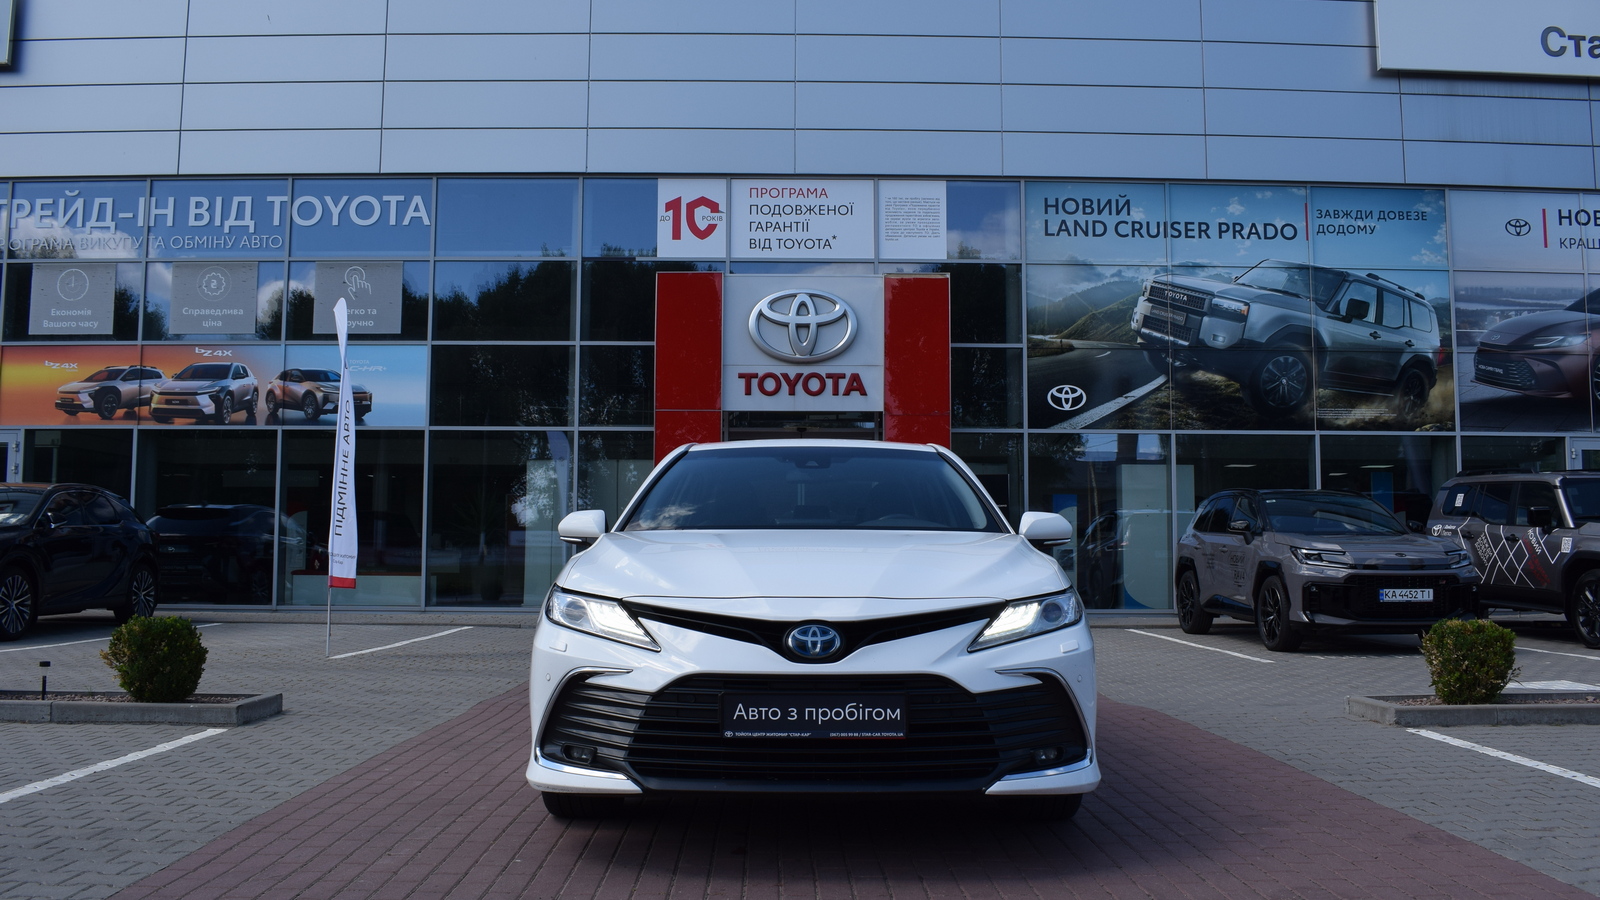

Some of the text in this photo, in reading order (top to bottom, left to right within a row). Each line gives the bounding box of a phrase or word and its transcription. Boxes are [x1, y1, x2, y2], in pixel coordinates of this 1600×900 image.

[750, 187, 828, 198] ПРОГРАМА
[750, 202, 854, 217] ПОДОВЖЕНОЇ
[1044, 194, 1131, 216] НОВИЙ
[188, 196, 255, 233] ВІД
[267, 196, 431, 226] TOYOTA
[1316, 209, 1428, 222] ЗАВЖДИ ДОВЕЗЕ
[750, 219, 810, 232] ГАРАНТІЇ
[1044, 220, 1298, 240] LAND CRUISER PRADO
[1316, 224, 1376, 236] ДОДОМУ
[80, 236, 144, 250] ВИКУПУ
[148, 236, 165, 249] ТА
[170, 235, 236, 249] ОБМІНУ
[240, 235, 282, 249] АВТО
[750, 238, 772, 251] ВІД
[1165, 291, 1187, 301] TOYOTA
[51, 308, 92, 316] Економія
[182, 307, 244, 316] Справедлива
[43, 320, 98, 329] Вашого часу
[202, 320, 222, 328] ціна
[738, 372, 867, 396] TOYOTA
[334, 449, 349, 536] ПІДМІННЕ
[1399, 590, 1418, 599] 4452
[733, 703, 900, 724] Авто з пробігом
